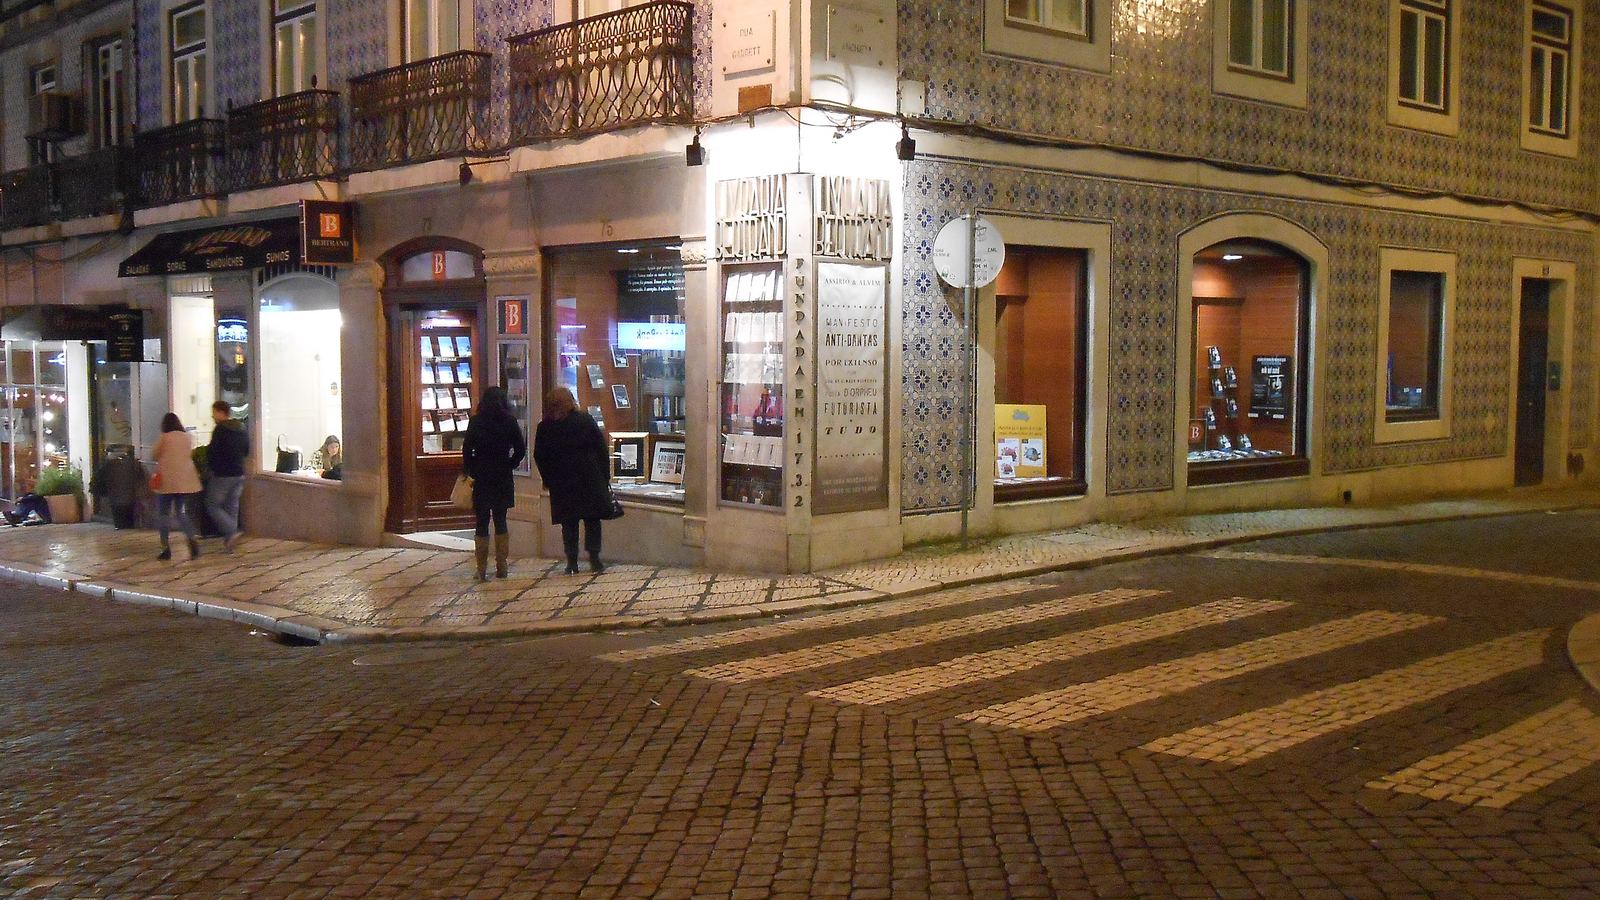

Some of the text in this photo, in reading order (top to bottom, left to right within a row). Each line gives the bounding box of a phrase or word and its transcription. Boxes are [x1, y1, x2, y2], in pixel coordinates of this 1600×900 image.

[326, 215, 338, 232] B
[311, 239, 349, 247] BERTRAND
[265, 250, 290, 264] SUMOS
[435, 253, 444, 274] B
[508, 303, 519, 327] B
[825, 318, 878, 328] MANIFESTO
[825, 333, 878, 347] ANTI-DANTAS
[825, 359, 842, 367] POR
[824, 401, 878, 416] FUTURISTA
[824, 425, 877, 435] TUDO
[1191, 426, 1201, 439] B
